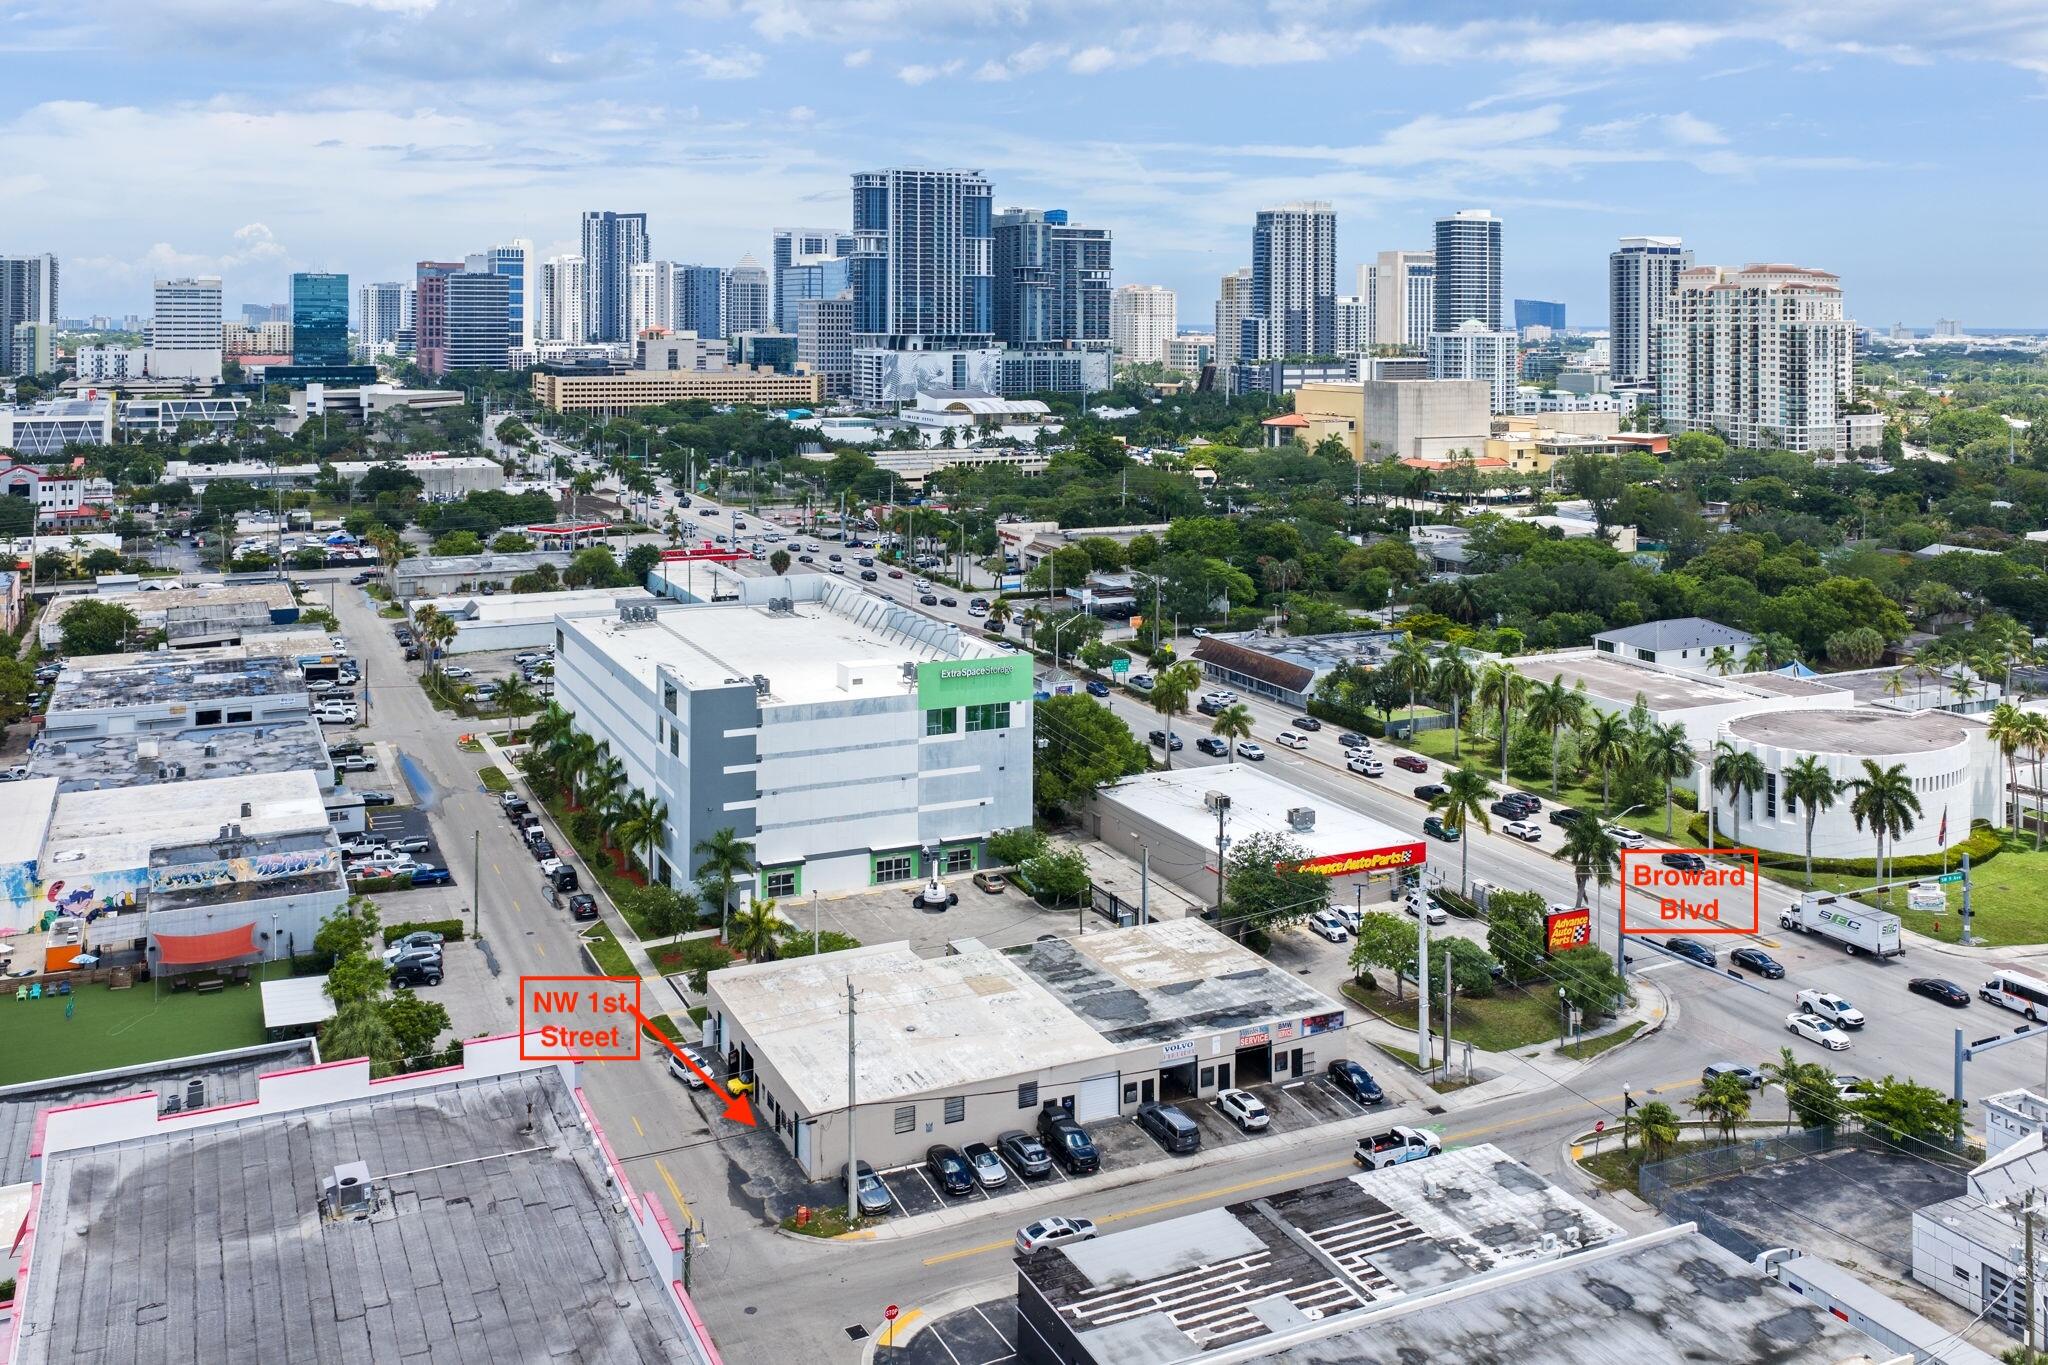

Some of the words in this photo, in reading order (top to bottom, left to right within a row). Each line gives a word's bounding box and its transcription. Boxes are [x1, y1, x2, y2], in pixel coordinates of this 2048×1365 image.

[1343, 858, 1372, 871] Auto
[1371, 851, 1402, 867] Parts
[1554, 916, 1588, 929] Advance
[1551, 927, 1573, 938] Auto
[1549, 936, 1570, 947] Parts
[1240, 1033, 1269, 1046] SERVICE
[1164, 1041, 1194, 1052] VOLVO
